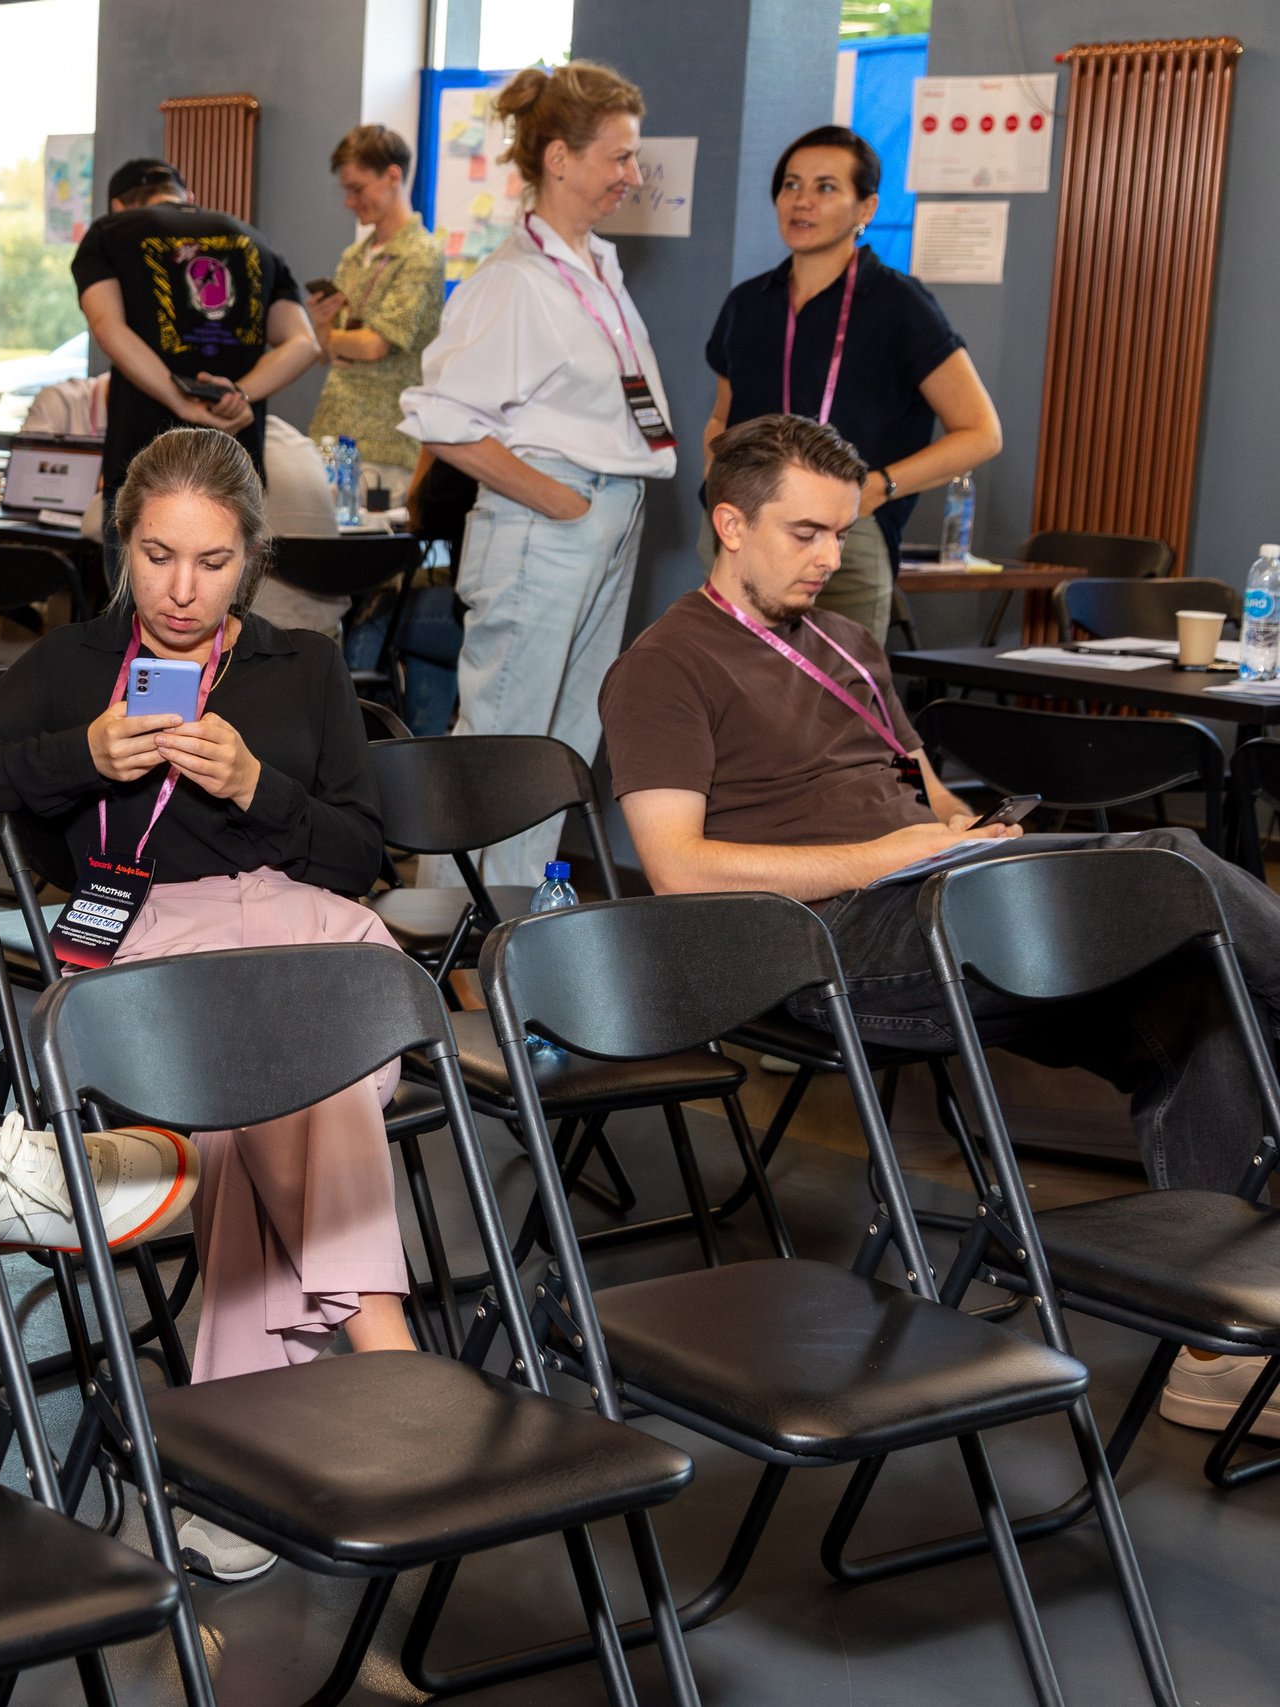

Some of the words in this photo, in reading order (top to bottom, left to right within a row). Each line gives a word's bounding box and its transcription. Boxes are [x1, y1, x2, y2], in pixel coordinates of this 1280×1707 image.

[89, 859, 113, 871] spark
[115, 864, 135, 875] Альфа
[135, 868, 150, 878] Банк
[90, 883, 132, 899] УЧАСТНИК
[77, 901, 117, 918] ТАТЬЯНА
